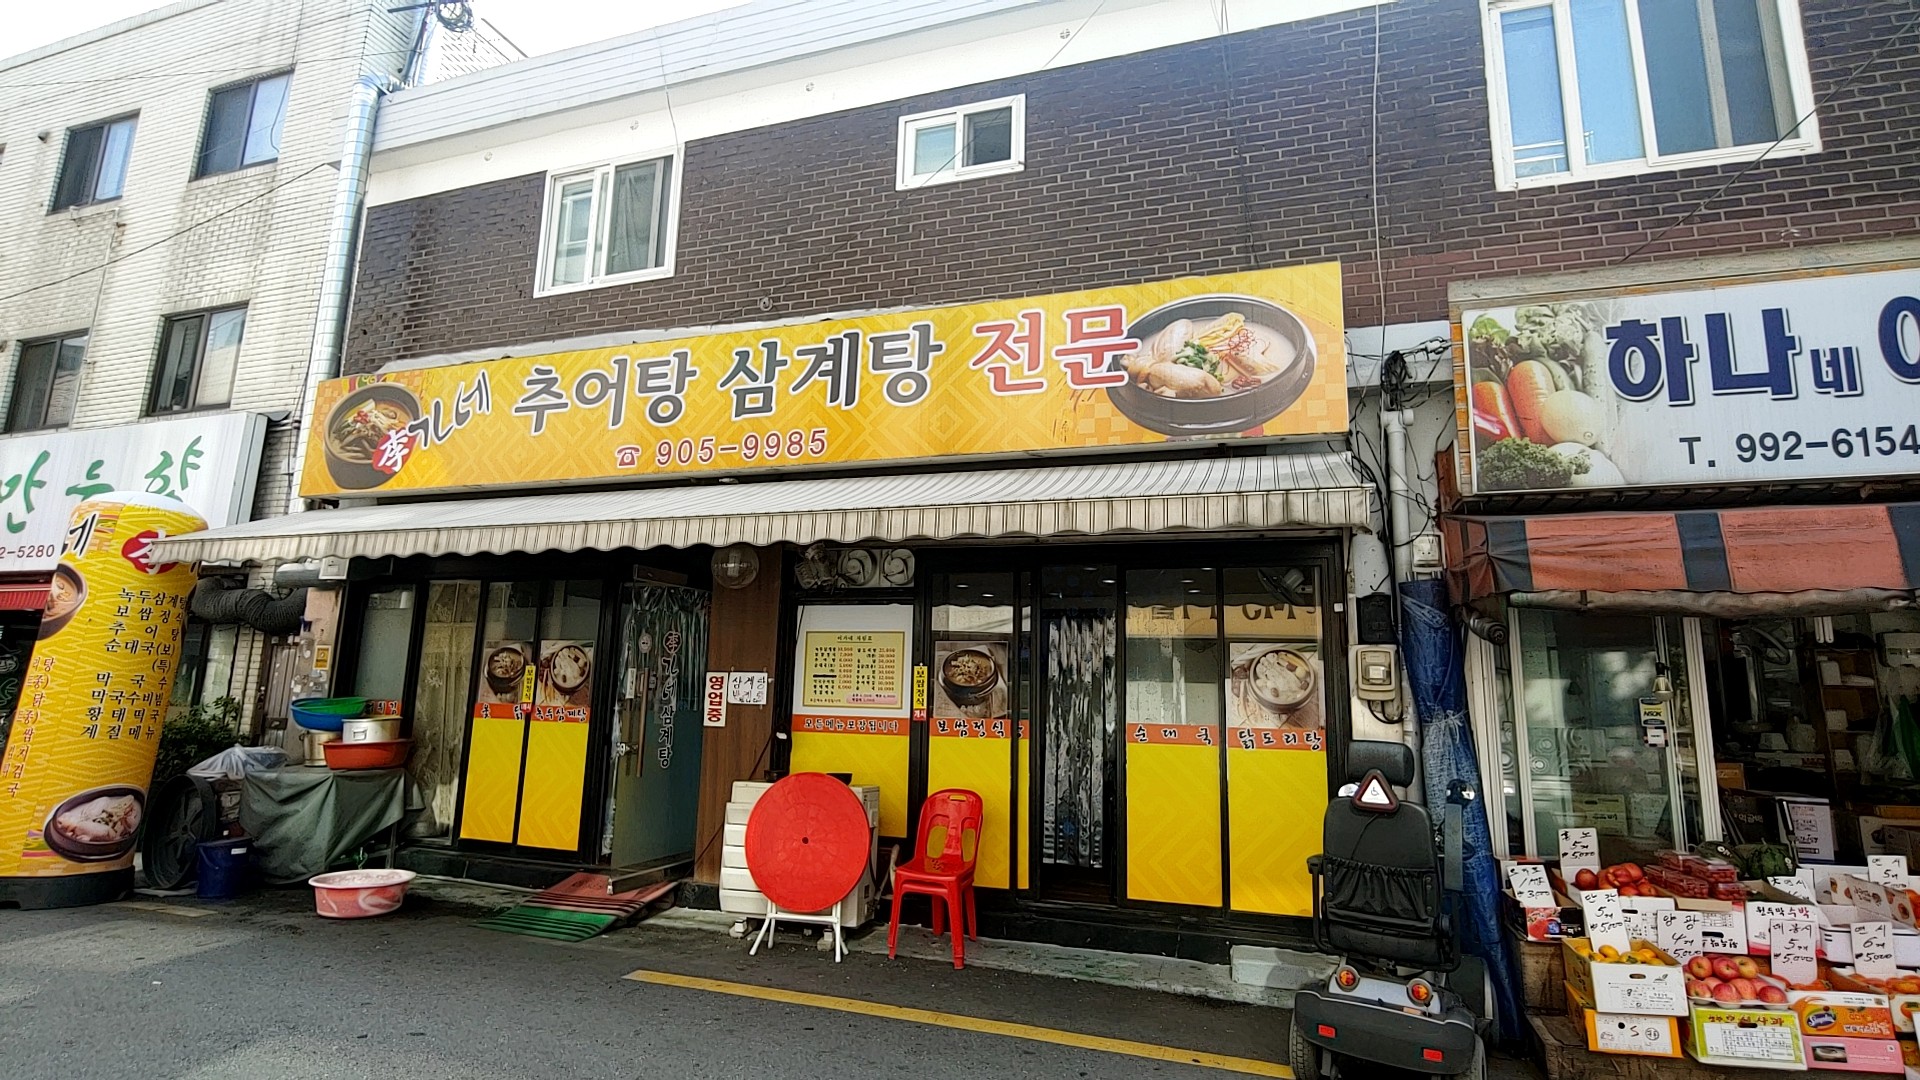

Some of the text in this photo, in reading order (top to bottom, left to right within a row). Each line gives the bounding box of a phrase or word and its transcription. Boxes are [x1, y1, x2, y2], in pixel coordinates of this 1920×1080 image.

[513, 350, 697, 435] 추어탕
[718, 322, 943, 420] 삼계탕
[972, 306, 1140, 392] 전문
[1606, 307, 1863, 404] 하나네
[657, 430, 827, 466] 905-9985
[1678, 424, 1920, 468] T. 992-6154
[706, 675, 724, 723] 영업중
[916, 670, 926, 706] 보쌈정식
[536, 705, 587, 722] 녹두삼계탕
[937, 720, 1005, 737] 보쌈정식
[658, 705, 675, 769] 삼계탕
[1237, 728, 1322, 751] 닭도리탕
